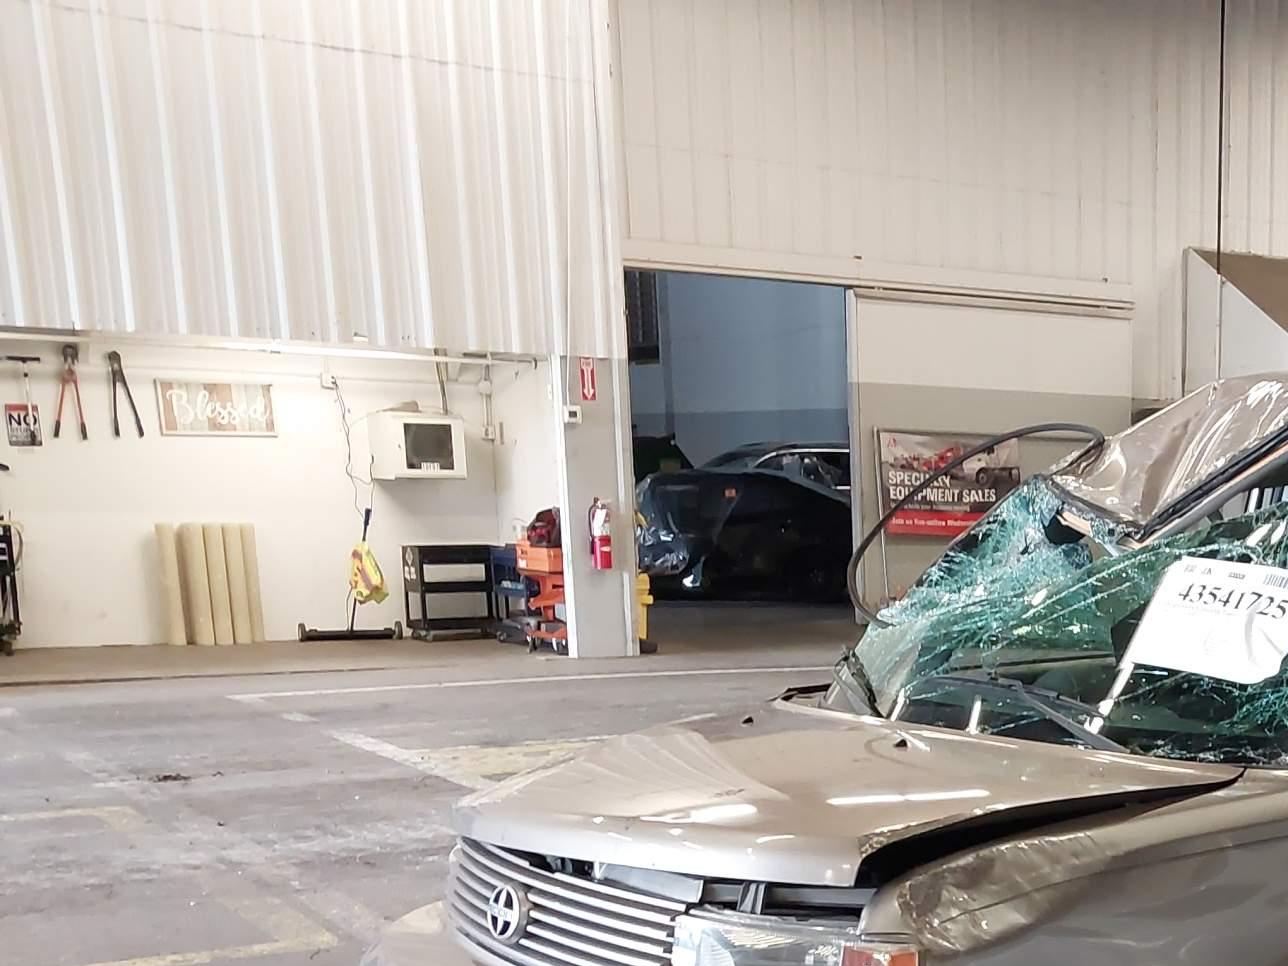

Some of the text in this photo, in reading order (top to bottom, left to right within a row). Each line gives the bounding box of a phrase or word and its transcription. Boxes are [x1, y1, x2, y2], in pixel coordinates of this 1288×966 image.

[166, 389, 270, 425] Blessed
[8, 413, 37, 426] NO
[889, 485, 996, 503] EQUPMENT SALES
